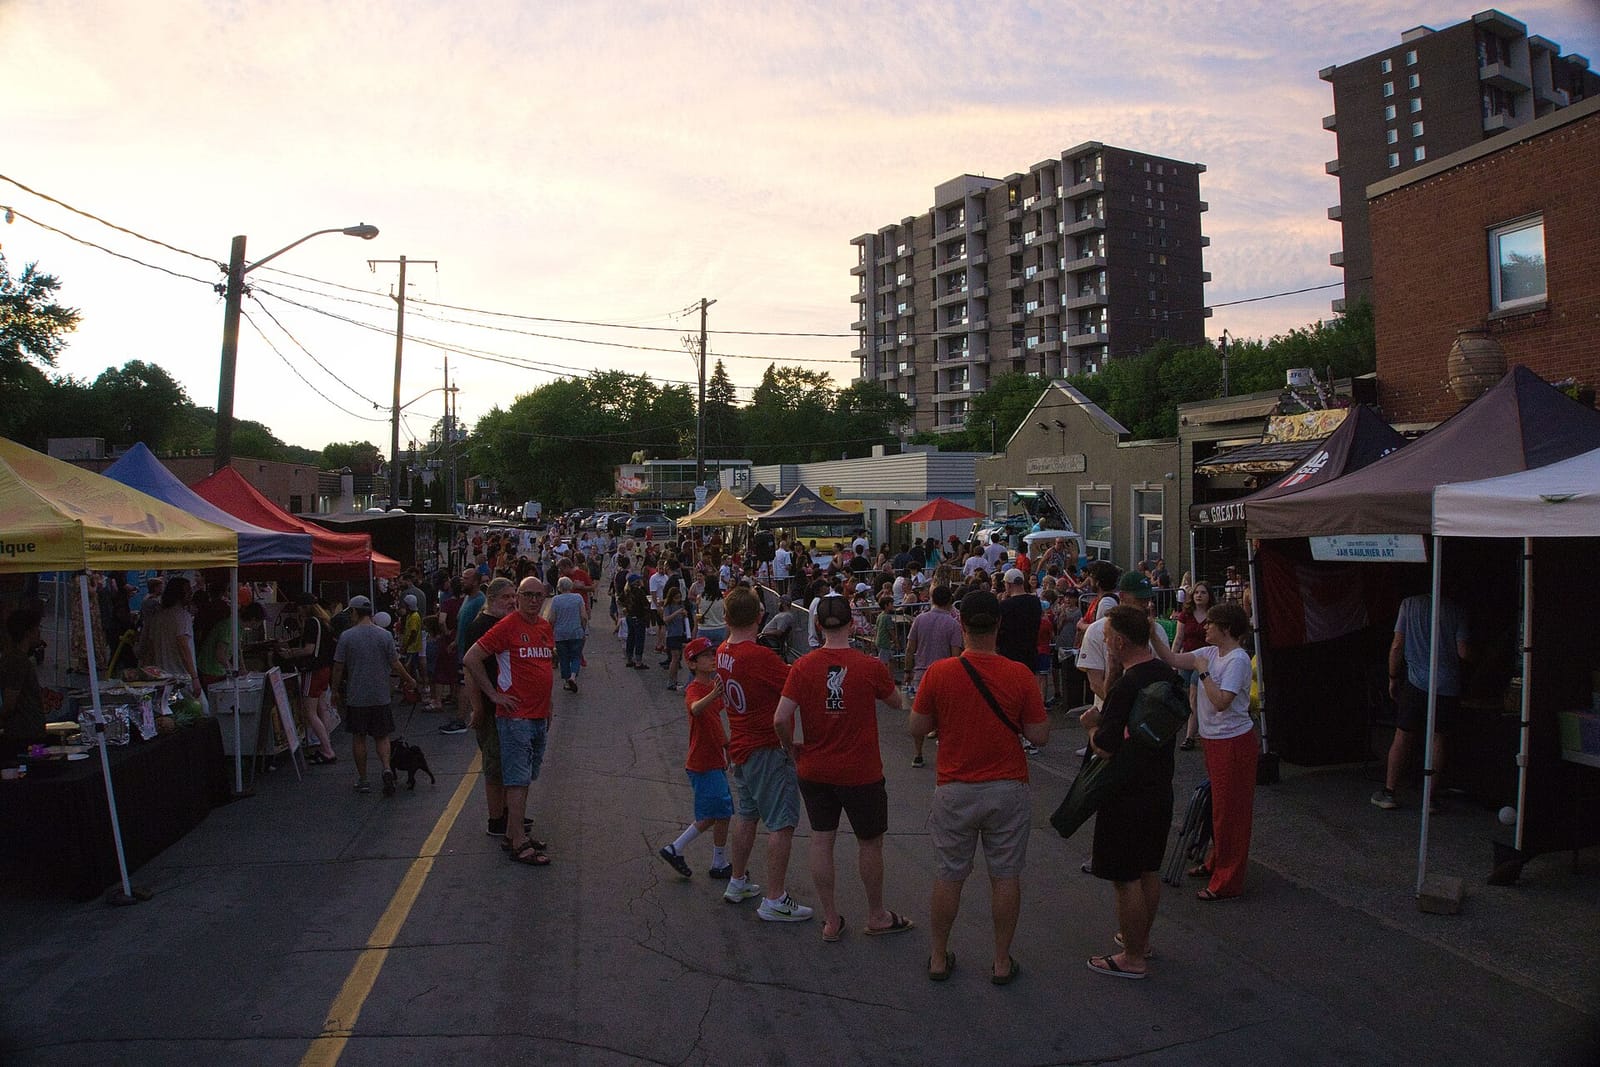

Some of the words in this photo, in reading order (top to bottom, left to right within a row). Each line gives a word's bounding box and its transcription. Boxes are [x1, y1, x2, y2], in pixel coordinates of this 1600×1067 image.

[735, 472, 747, 482] 35
[1211, 504, 1234, 523] GREAT
[1335, 548, 1349, 557] JAN
[1382, 548, 1395, 558] ART
[717, 653, 736, 673] KIRK
